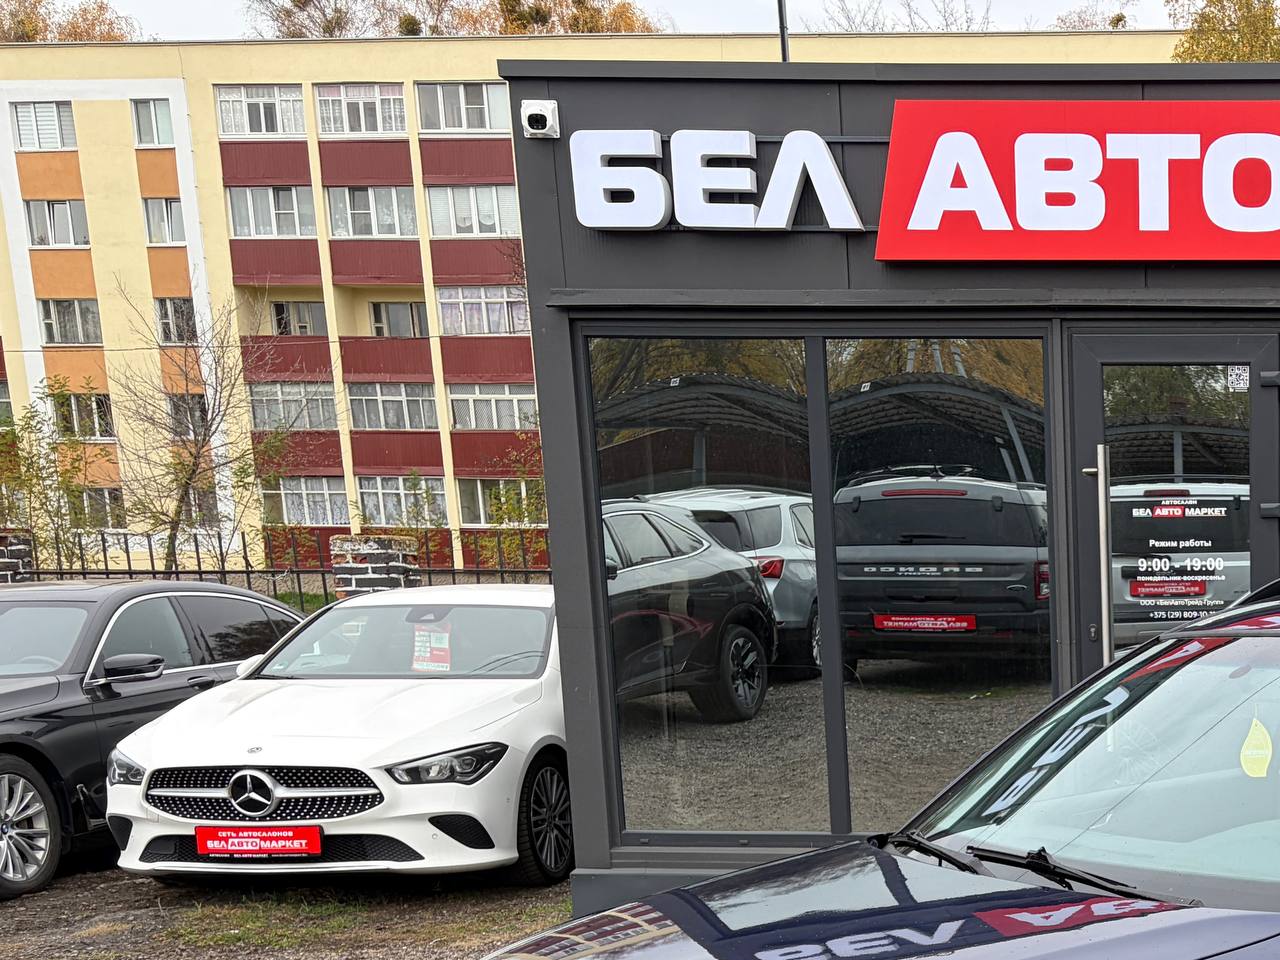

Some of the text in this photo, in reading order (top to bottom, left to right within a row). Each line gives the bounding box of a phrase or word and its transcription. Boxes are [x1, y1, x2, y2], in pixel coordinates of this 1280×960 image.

[569, 129, 865, 232] БЕЛ
[1132, 507, 1227, 516] БЕЛ АВТО МАРКЕТ
[1149, 539, 1212, 549] Режим работы
[1138, 558, 1170, 571] 9:00
[1184, 557, 1224, 571] 19:00
[1149, 611, 1166, 619] +375
[1167, 611, 1182, 619] (29)
[207, 839, 307, 848] БЕЛ АВТО МАРКЕТ
